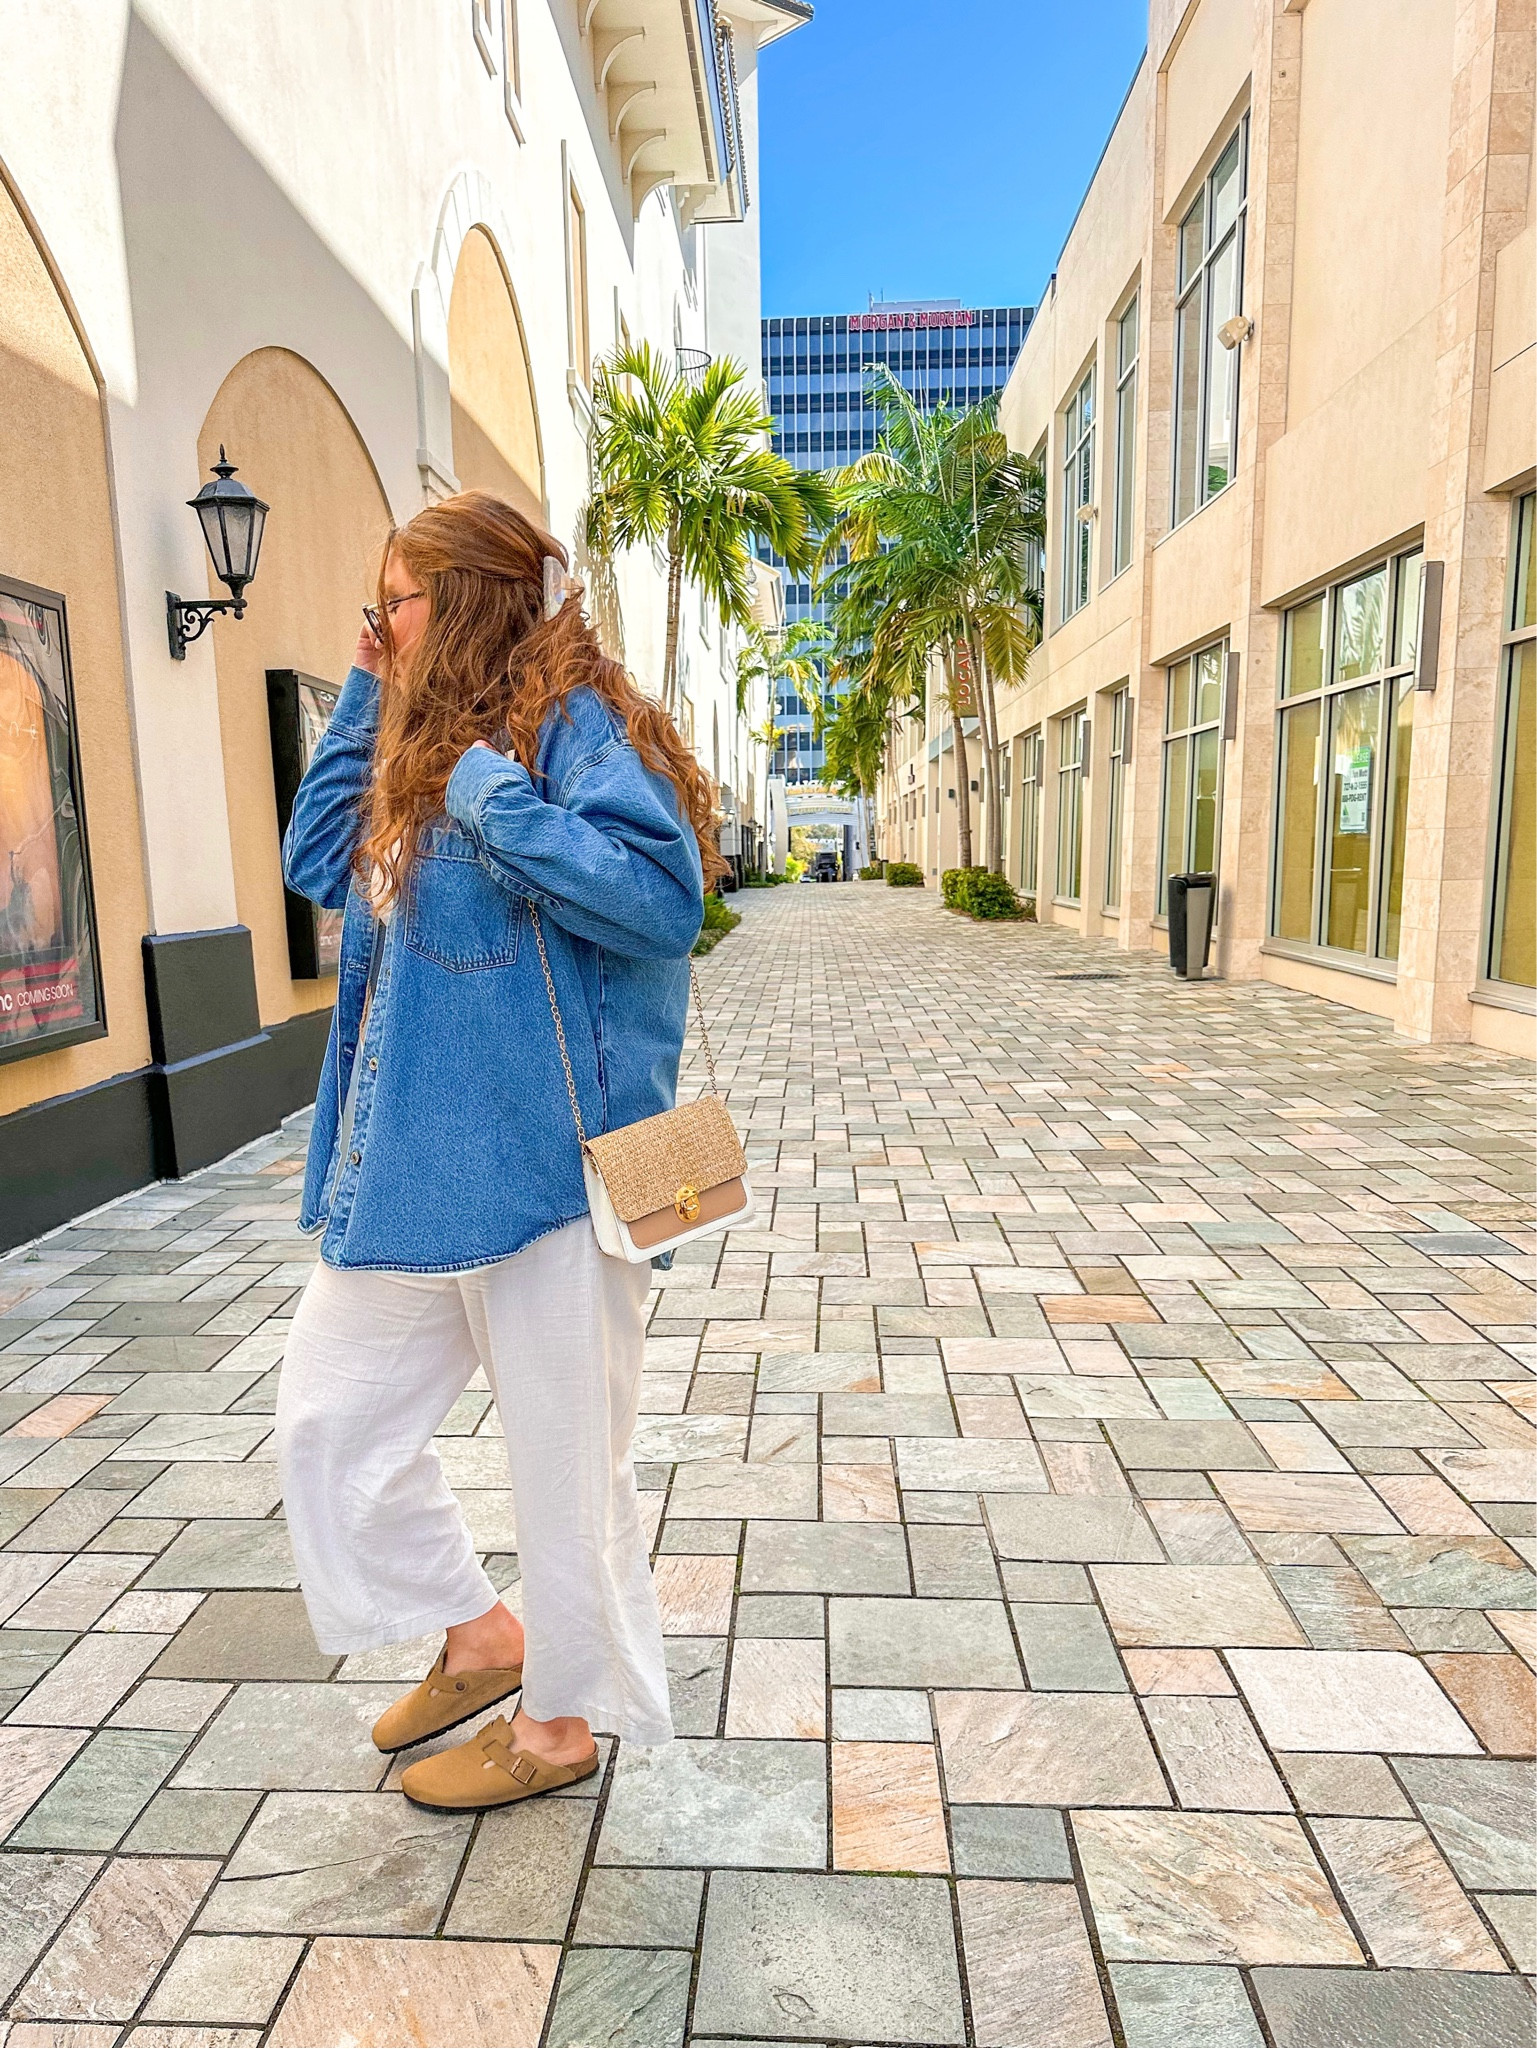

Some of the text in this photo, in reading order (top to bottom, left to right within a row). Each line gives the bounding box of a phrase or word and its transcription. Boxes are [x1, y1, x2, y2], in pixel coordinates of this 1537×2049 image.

[850, 310, 974, 330] MORGAN & MORGAN
[17, 987, 50, 1007] COMING
[50, 983, 74, 999] SOON
